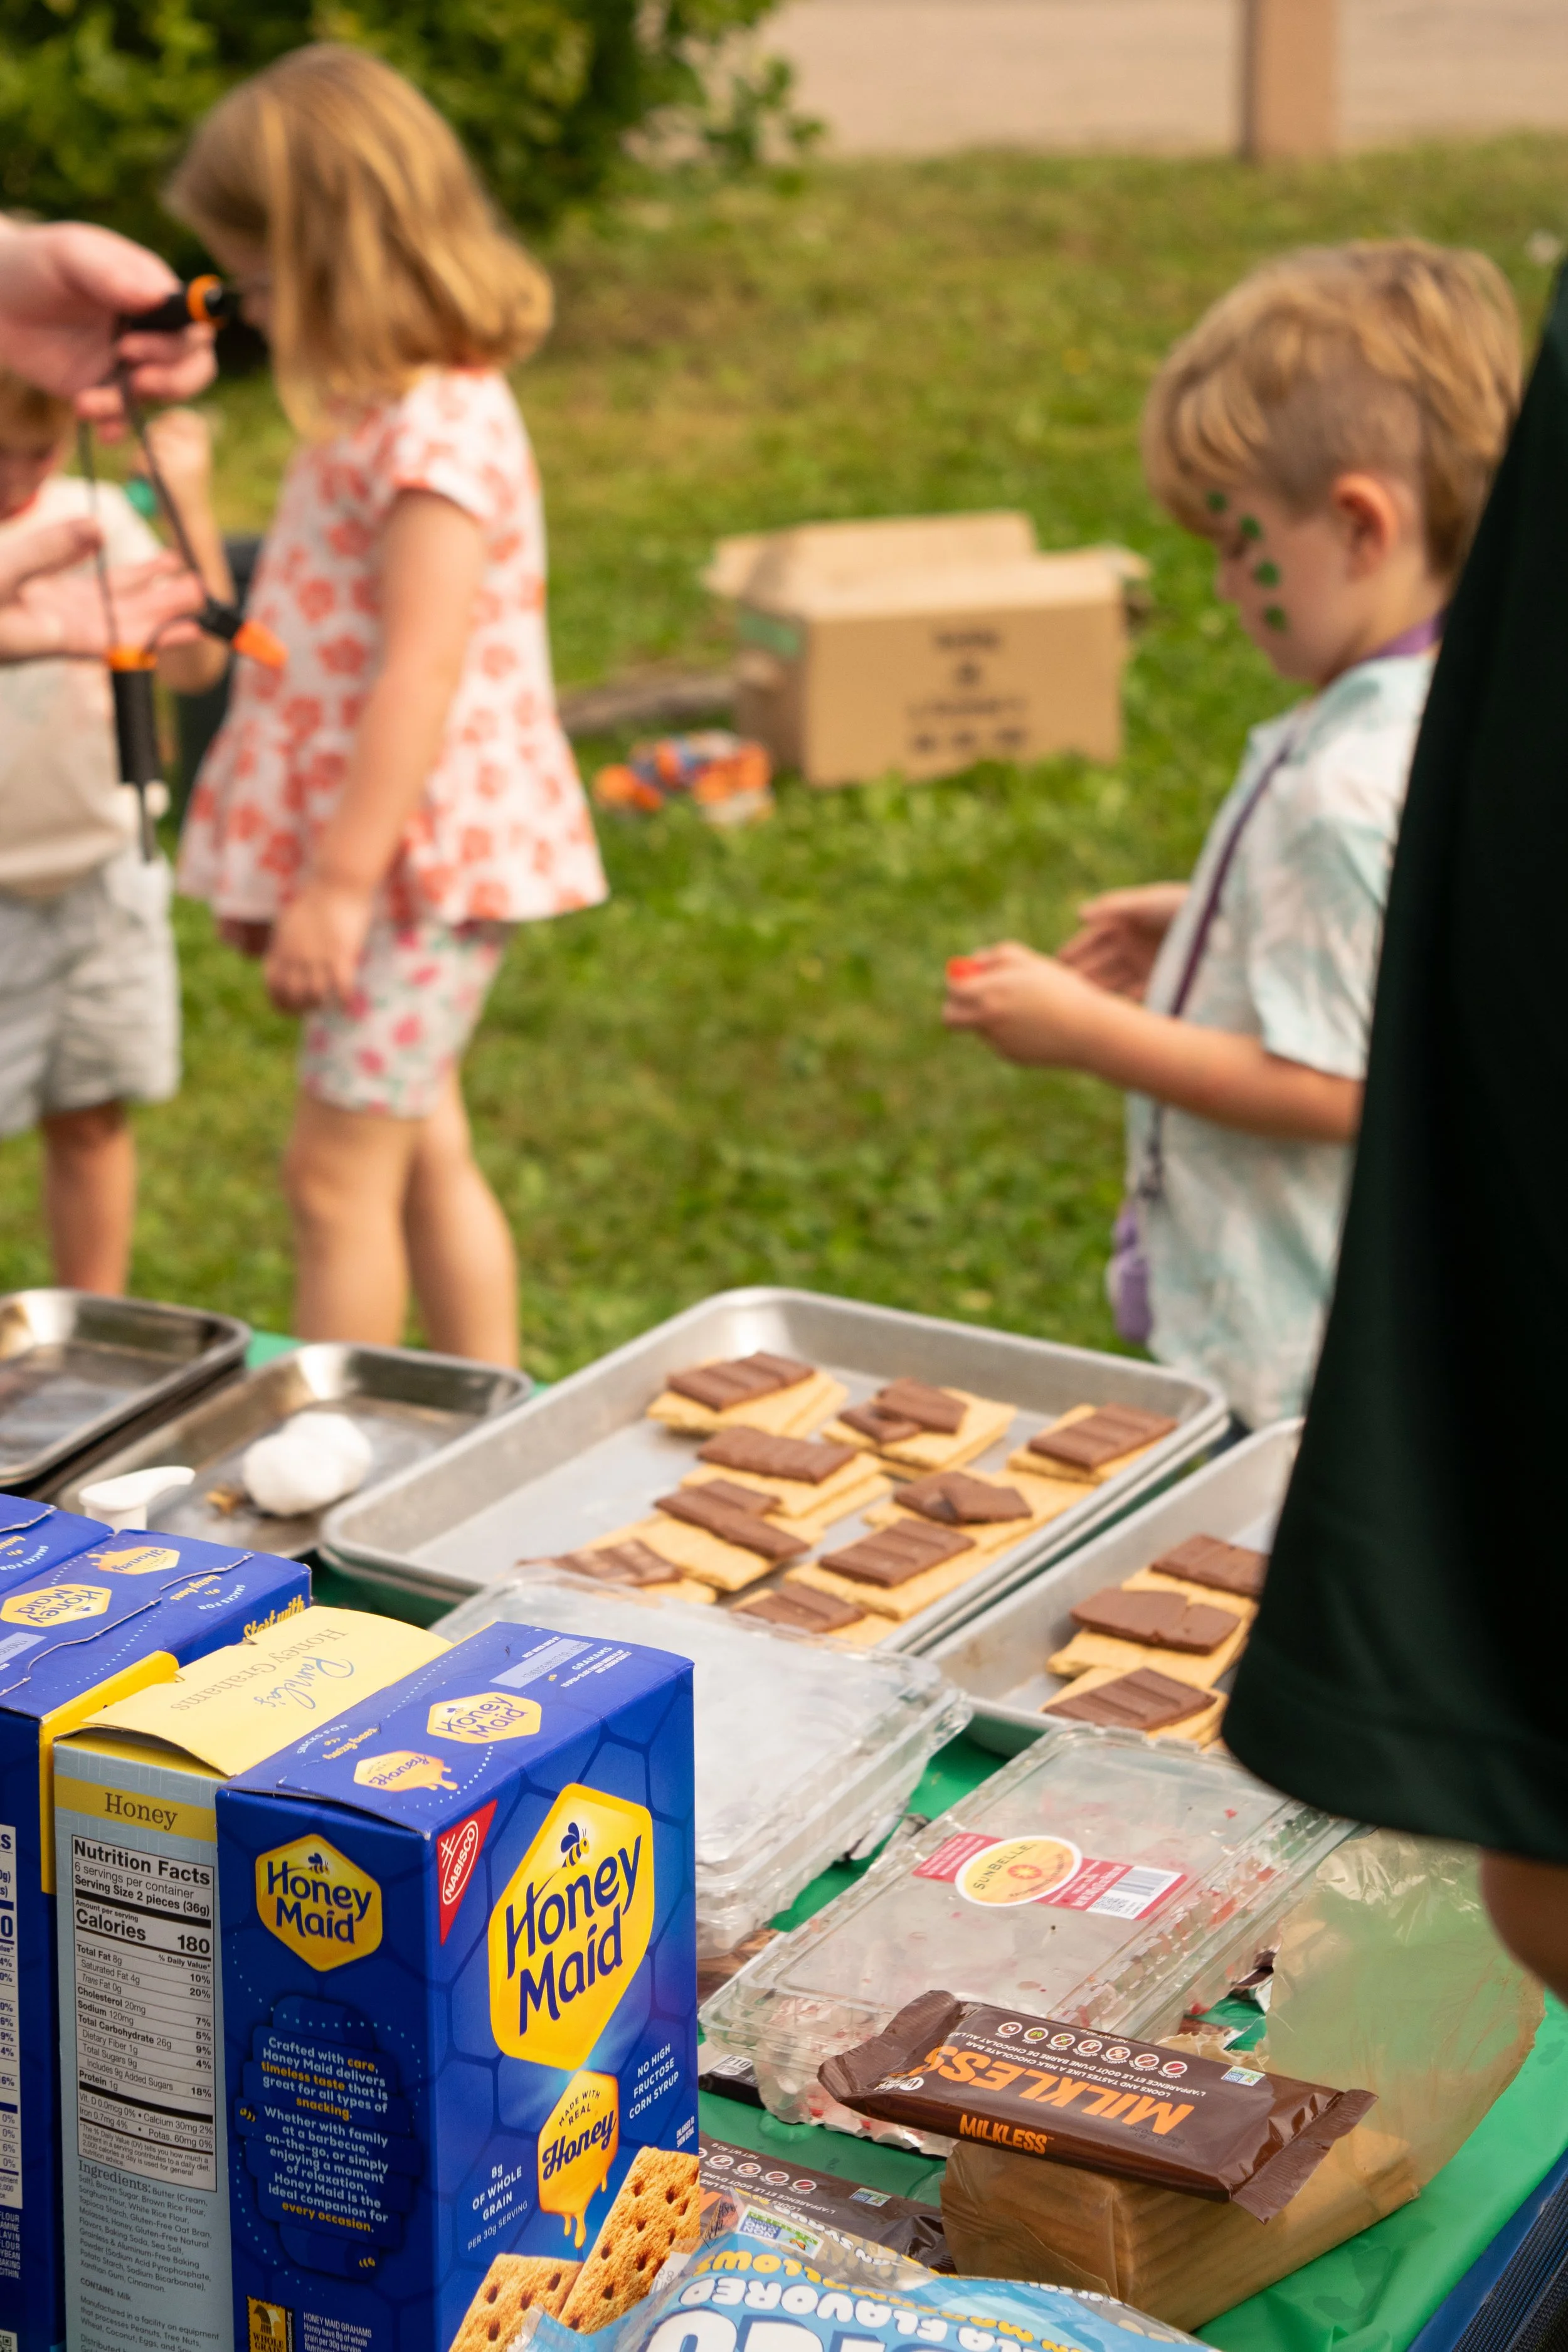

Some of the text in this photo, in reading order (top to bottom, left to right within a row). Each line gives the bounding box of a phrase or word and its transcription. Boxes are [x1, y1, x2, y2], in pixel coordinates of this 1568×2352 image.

[23, 1545, 49, 1568] SNACKS
[112, 1549, 167, 1572] Honey
[13, 1588, 67, 1616] Maid
[26, 1589, 103, 1624] Honey
[198, 1584, 246, 1611] SNACKS FOR
[171, 1629, 349, 1710] Honey Grahams
[571, 1646, 613, 1670] GRAHAMS
[435, 1696, 516, 1735] Honey
[466, 1709, 529, 1738] Maid
[297, 1724, 349, 1754] SNACKS FOR
[368, 1754, 430, 1786] Honey
[105, 1792, 178, 1831] Honey
[74, 1839, 210, 1885] Nutrition Facts
[444, 1827, 475, 1899] NABISCO
[75, 1862, 194, 1899] 6 servings per container
[75, 1875, 209, 1917] Serving Size 2 pieces (36g)
[267, 1860, 373, 1923] Honey
[76, 1900, 139, 1923] Amount per serving
[276, 1896, 356, 1945] Maid
[505, 1835, 643, 1979] Honey
[76, 1908, 210, 1954] Calories 180
[77, 1944, 211, 1984] Total Fat 8g 10%
[167, 1956, 185, 1968] Daily
[519, 1909, 624, 2036] Maid
[81, 1959, 211, 1999] Saturated Fat 4g 20%
[78, 1986, 211, 2028] Cholesterol 20mg 7%
[78, 2000, 211, 2042] Sodium 120mg 5%
[268, 2037, 378, 2075] Crafted with care,
[965, 2042, 985, 2051] BAR
[979, 2036, 1026, 2054] CHOCOLAT
[985, 2047, 1036, 2065] CHOCOLATE
[1111, 2036, 1128, 2044] NET
[263, 2047, 386, 2087] Honey Maid delivers
[637, 2043, 670, 2079] NO HIGH
[726, 2057, 751, 2069] 210
[1037, 2062, 1057, 2070] MILK
[1039, 2054, 1067, 2064] BARRE
[1066, 2069, 1087, 2079] LIKE
[1069, 2061, 1096, 2070] D'UNE
[1096, 2067, 1121, 2077] GOÛT
[261, 2061, 388, 2101] timeless taste that is
[633, 2057, 675, 2099] FRUCTOSE
[908, 2046, 1194, 2135] MILKLESS
[1086, 2074, 1118, 2085] TASTES
[1120, 2081, 1138, 2090] AND
[1139, 2086, 1171, 2097] LOOKS
[1147, 2078, 1206, 2097] L'APPARENCE
[263, 2075, 388, 2114] great for all types of
[296, 2097, 352, 2121] snacking.
[559, 2089, 600, 2126] MADE WITH
[629, 2071, 679, 2119] CORN SYRUP
[568, 2102, 591, 2126] REAL
[542, 2110, 617, 2181] Honey
[959, 2114, 1048, 2155] MILKLESS
[728, 2148, 741, 2156] WT
[741, 2151, 760, 2160] NET
[78, 2160, 151, 2193] Ingredients:
[491, 2164, 503, 2180] 8g
[268, 2183, 388, 2223] ideal companion for
[275, 2172, 381, 2209] Honey Maid is the
[472, 2166, 522, 2211] OF WHOLE
[777, 2193, 837, 2215] L'APPARENCE
[282, 2201, 374, 2233] every occasion.
[482, 2191, 512, 2222] GRAIN
[467, 2200, 527, 2252] PER 30g SERVING
[743, 2225, 774, 2238] NON
[745, 2221, 777, 2233] GMO
[304, 2311, 373, 2338] HONEY MAID GRAHAMS
[680, 2277, 948, 2343] FLAVORED
